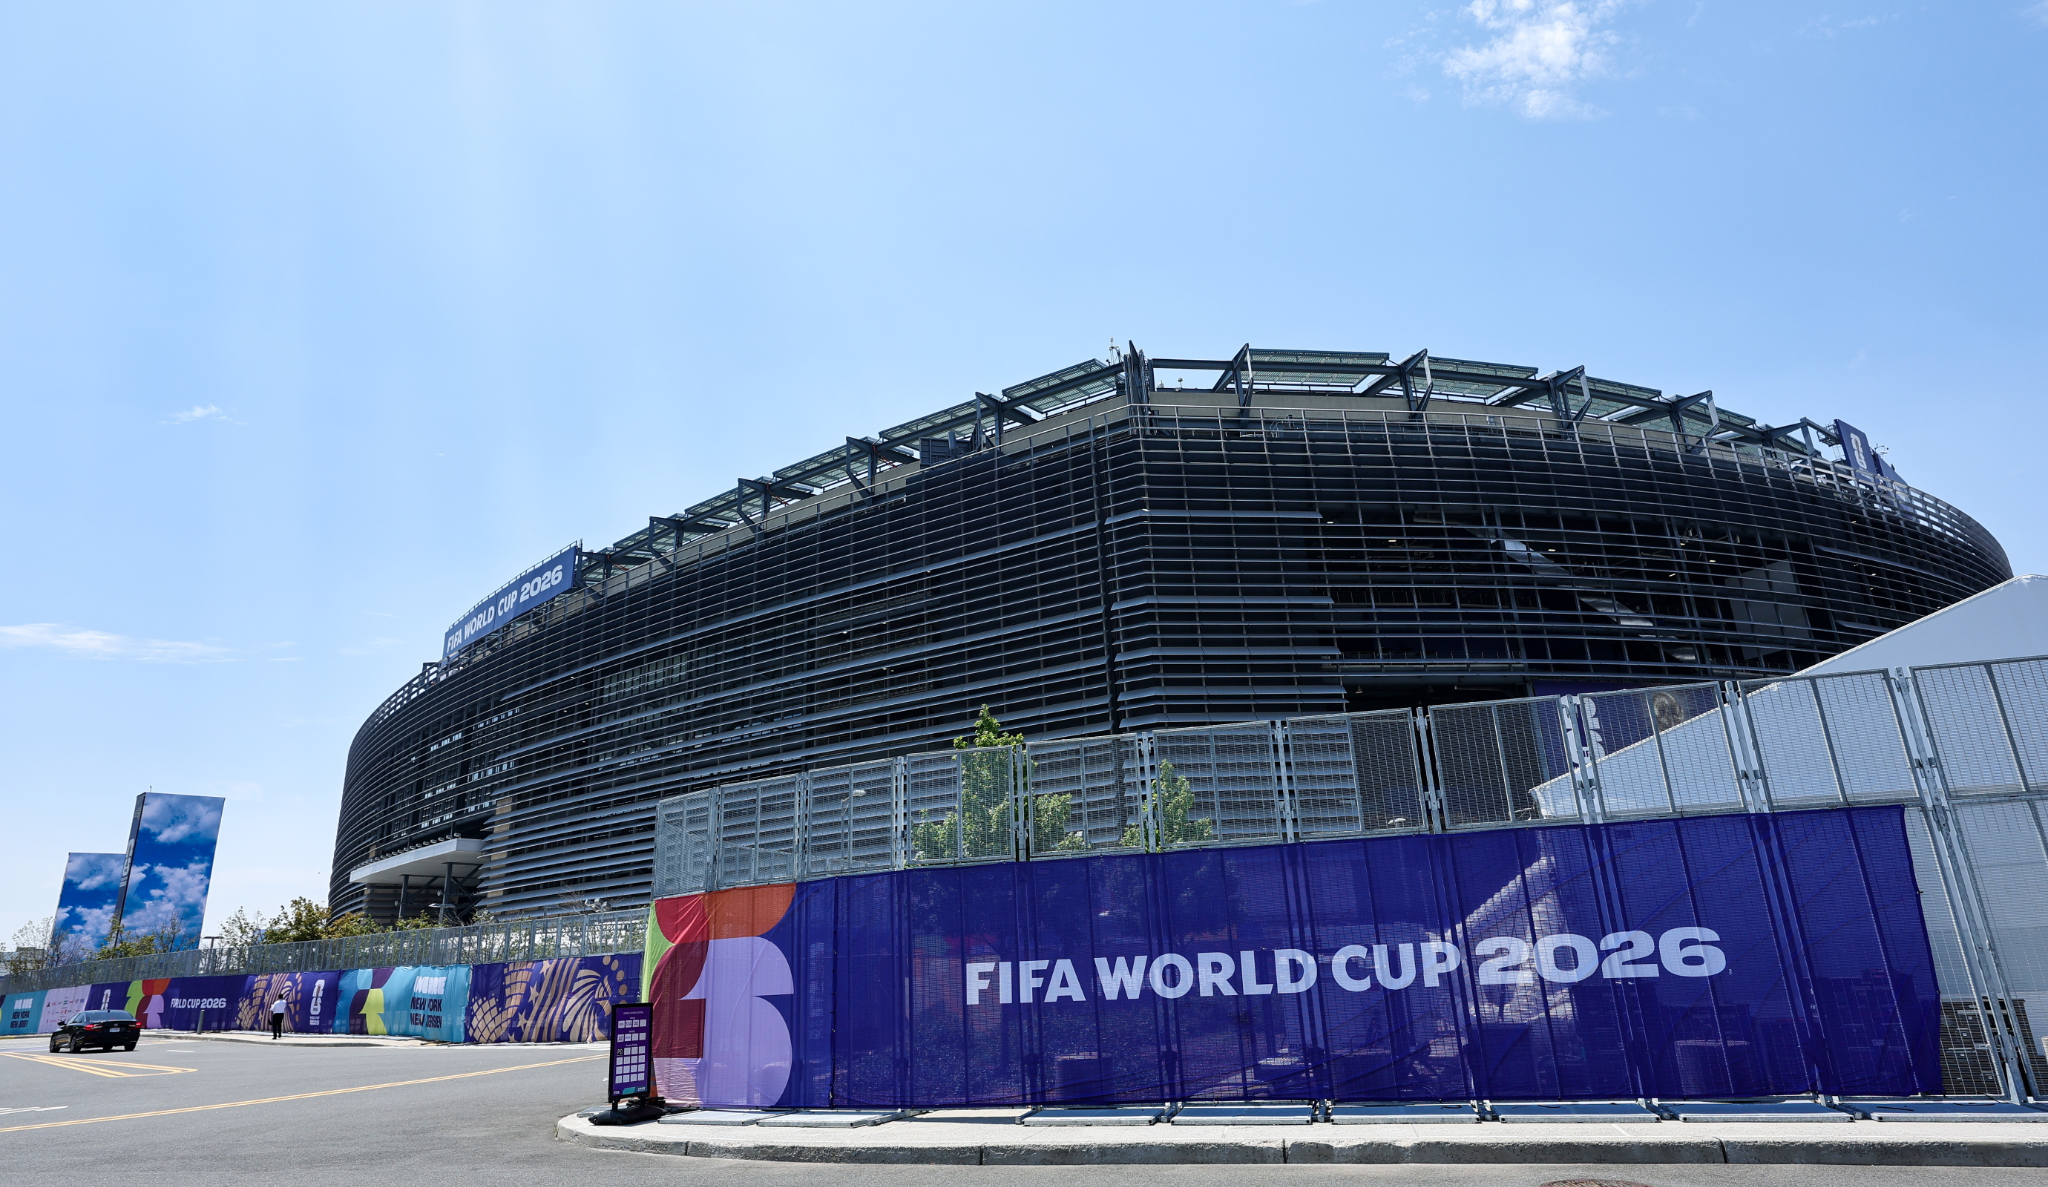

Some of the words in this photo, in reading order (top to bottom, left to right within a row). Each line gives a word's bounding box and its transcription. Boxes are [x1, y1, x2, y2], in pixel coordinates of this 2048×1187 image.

[447, 629, 462, 653] FIFA
[464, 605, 495, 640] WORLD
[497, 590, 518, 616] CUP
[520, 564, 563, 603] 2026
[966, 958, 1086, 1005] FIFA
[1094, 949, 1318, 1000] WORLD
[1331, 942, 1461, 992] CUP
[1475, 926, 1727, 986] 2026
[187, 998, 201, 1009] CUP
[200, 997, 227, 1008] 2026
[410, 996, 426, 1010] NEW
[427, 998, 442, 1012] ORK
[410, 1012, 425, 1026] NEW
